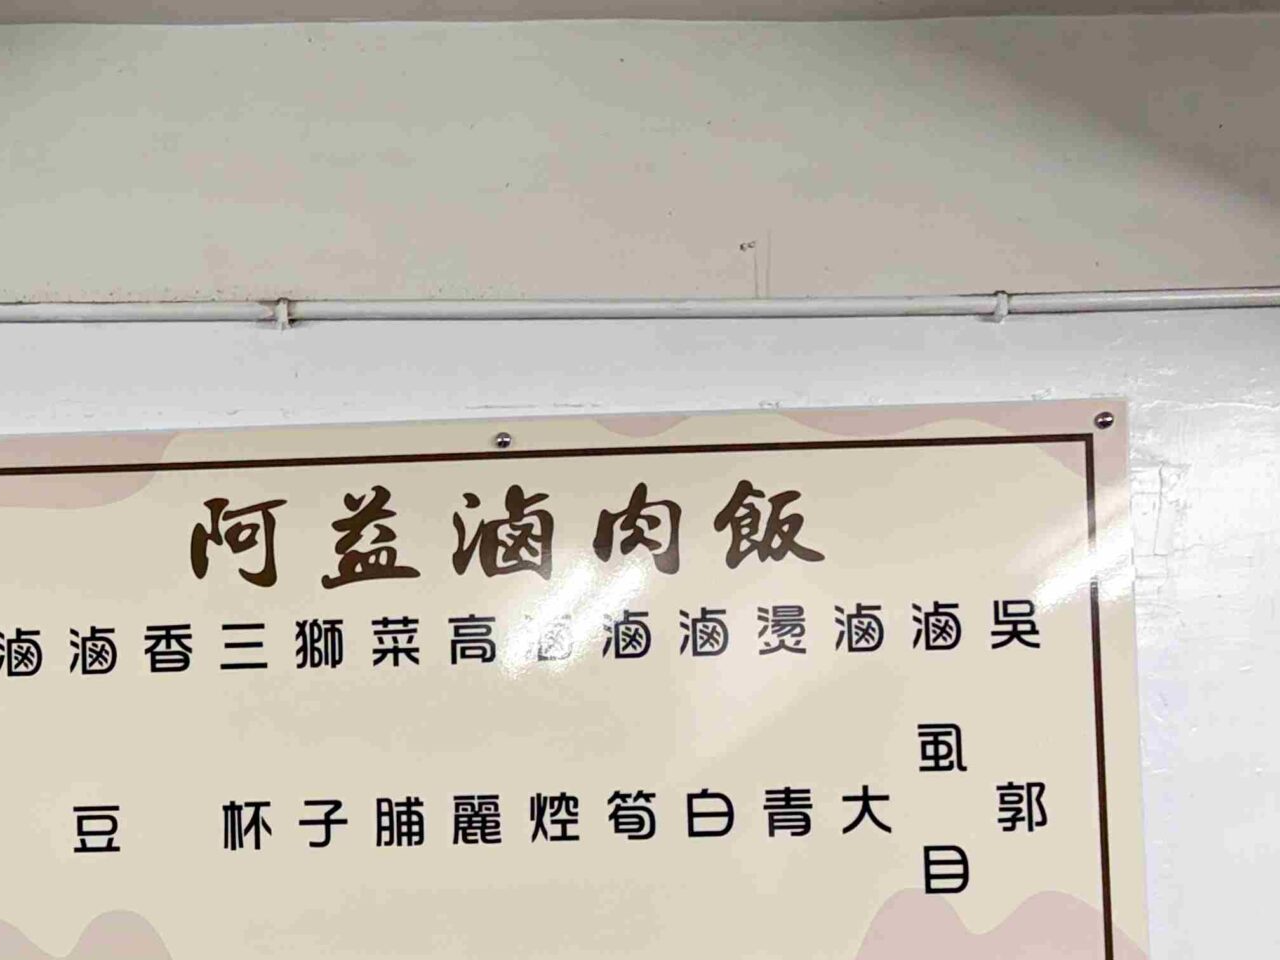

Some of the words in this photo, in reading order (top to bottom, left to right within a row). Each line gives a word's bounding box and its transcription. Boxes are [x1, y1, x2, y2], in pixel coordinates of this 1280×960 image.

[191, 480, 824, 586] 阿益滷肉飯
